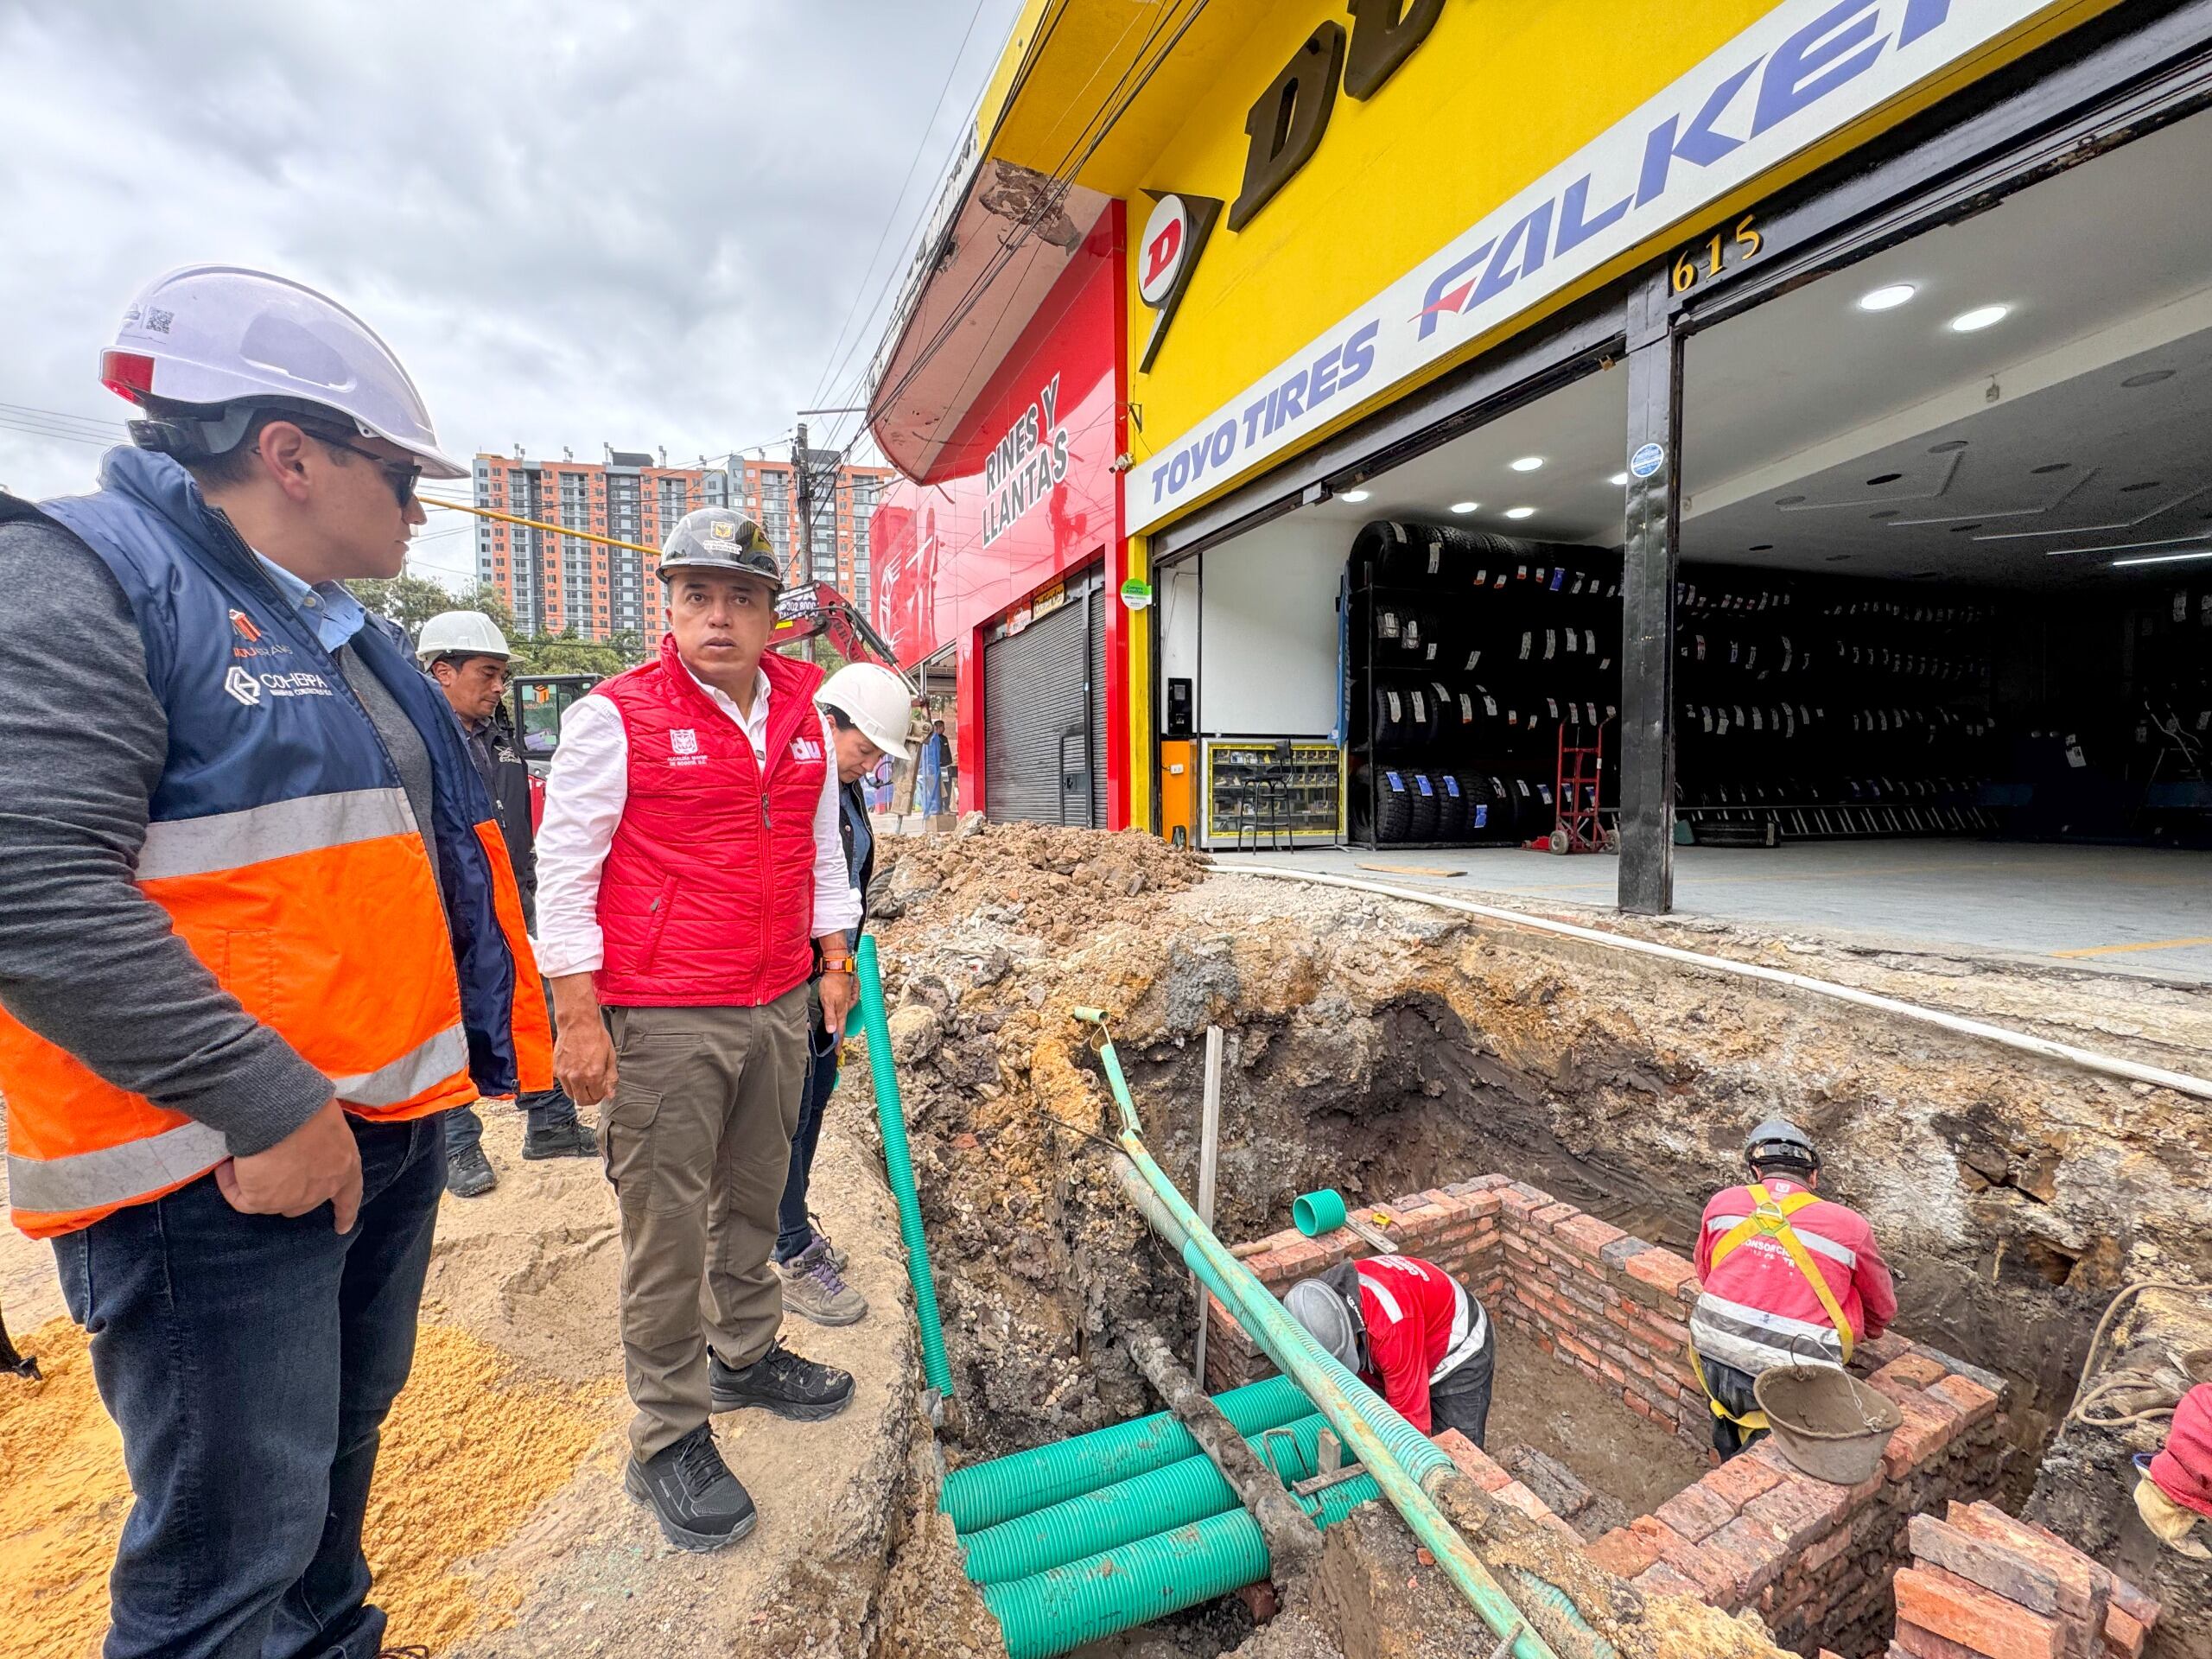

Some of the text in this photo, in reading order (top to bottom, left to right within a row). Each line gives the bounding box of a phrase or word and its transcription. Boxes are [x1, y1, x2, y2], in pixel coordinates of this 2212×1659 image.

[985, 372, 1060, 498] RINES Y
[1152, 319, 1381, 505] TOYO TIRES
[982, 427, 1069, 550] LLANTAS
